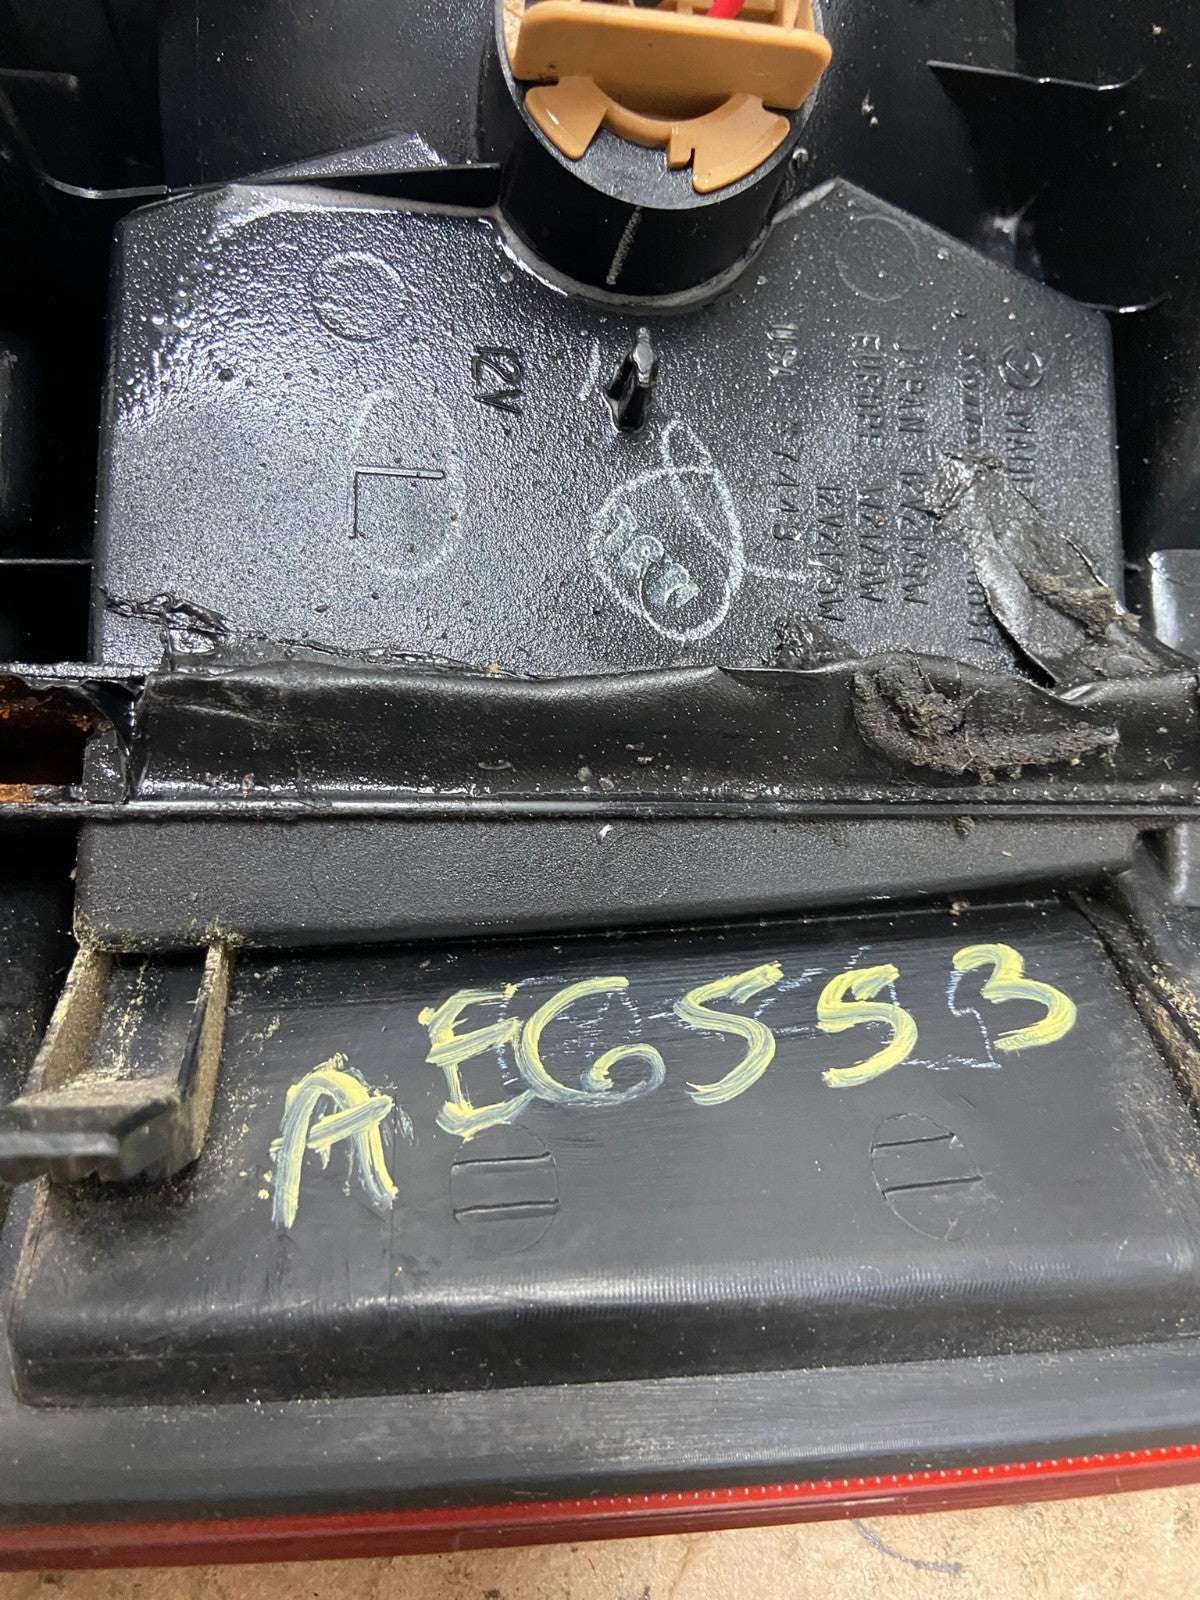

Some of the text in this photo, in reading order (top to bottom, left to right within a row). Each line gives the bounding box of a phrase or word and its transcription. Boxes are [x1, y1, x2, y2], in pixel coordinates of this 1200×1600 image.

[471, 348, 524, 414] 12V
[852, 331, 886, 449] EUROPE
[893, 342, 927, 433] JAPAN
